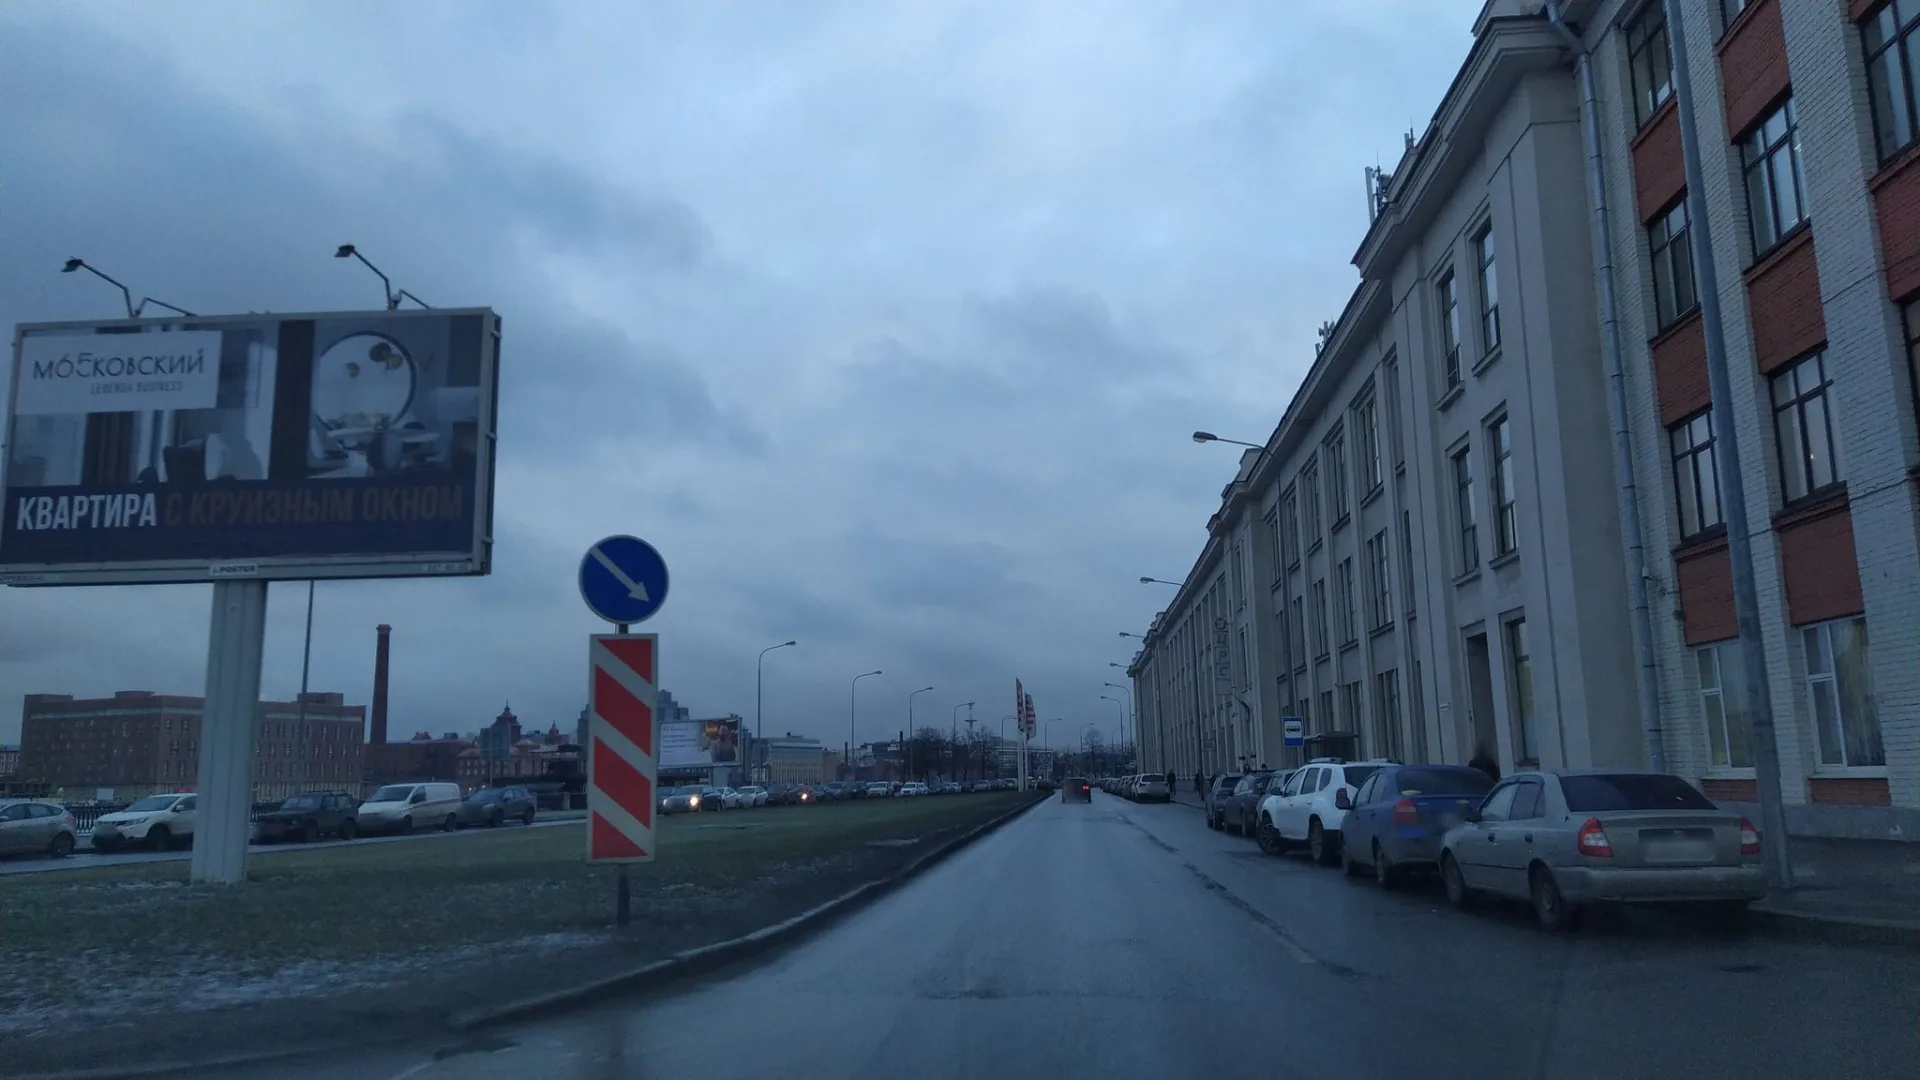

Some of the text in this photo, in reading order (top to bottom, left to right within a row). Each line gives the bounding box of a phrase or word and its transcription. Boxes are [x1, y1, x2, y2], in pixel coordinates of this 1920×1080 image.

[136, 380, 183, 394] BUSINESS
[16, 484, 464, 532] КВАРТИРА С КРУИЗНЫМ ОКНОМ
